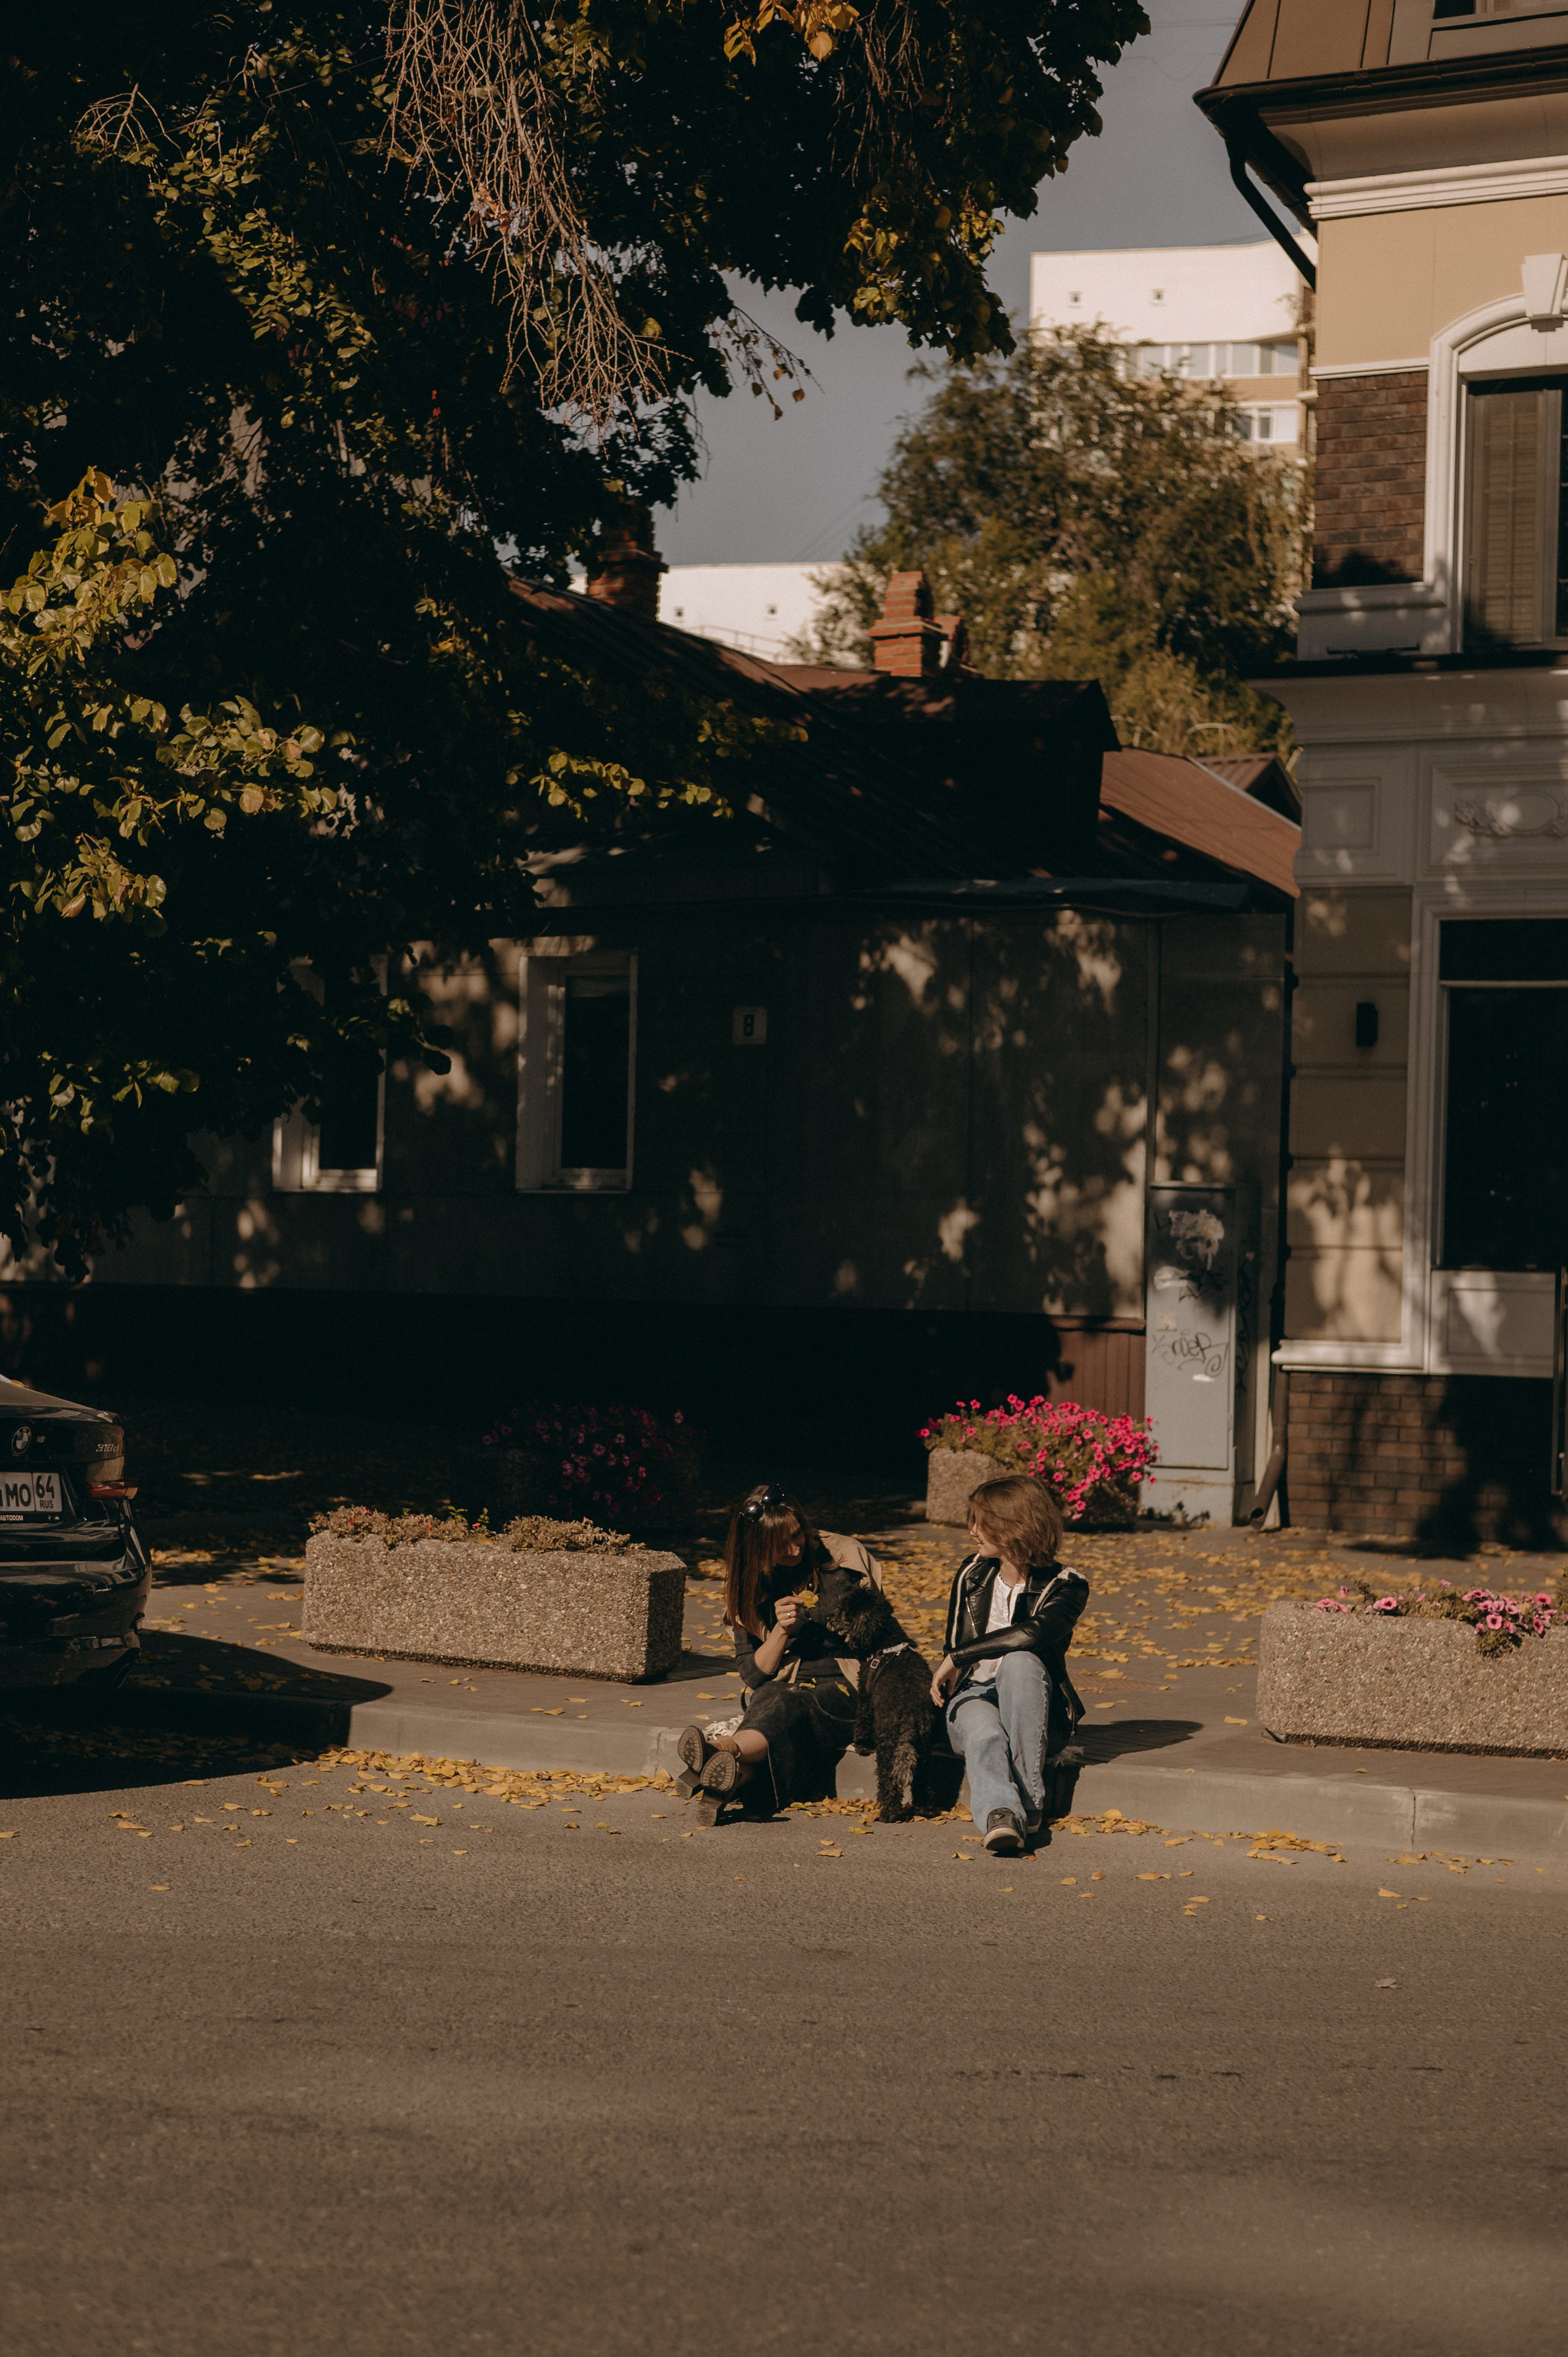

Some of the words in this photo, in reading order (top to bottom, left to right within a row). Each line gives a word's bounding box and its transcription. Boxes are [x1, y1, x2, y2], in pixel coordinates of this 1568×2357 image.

[744, 1014, 755, 1036] 8
[96, 1444, 119, 1452] 318d
[36, 1475, 55, 1499] 64
[40, 1500, 54, 1509] RUS
